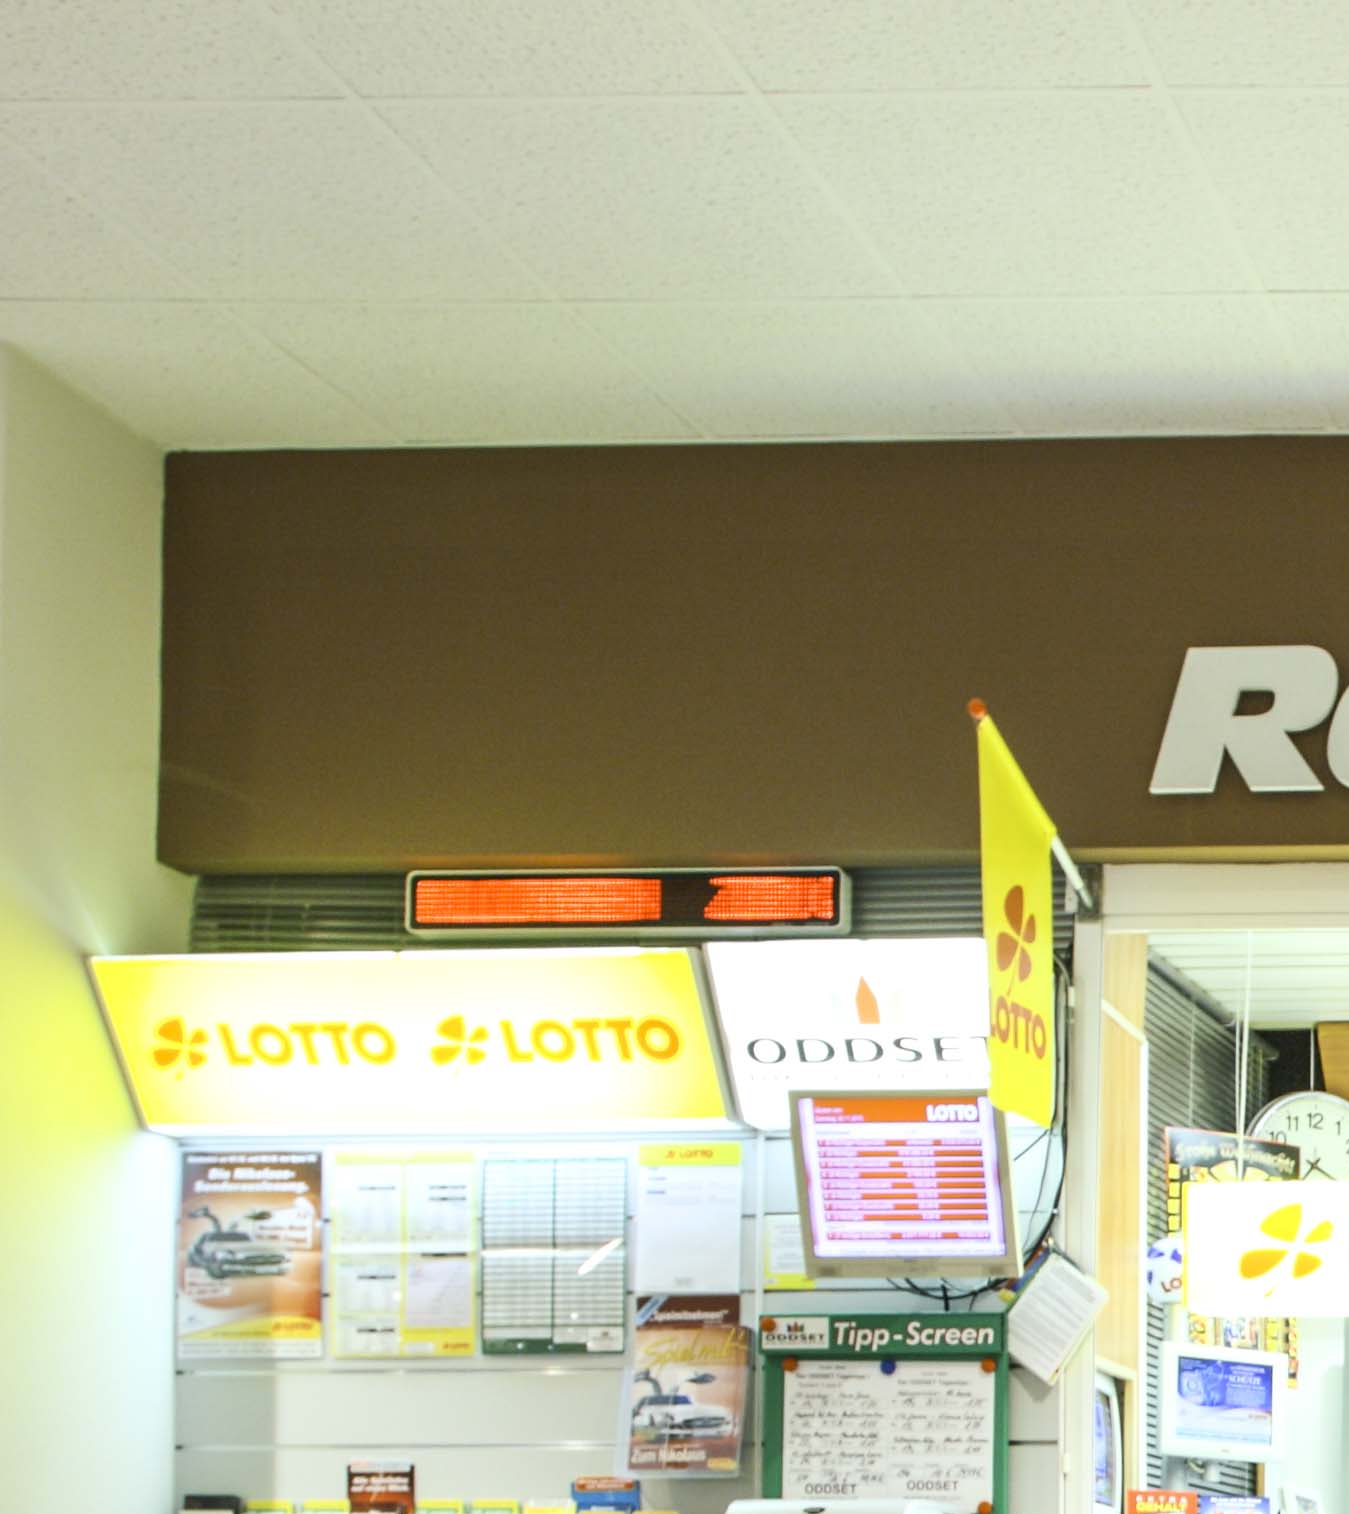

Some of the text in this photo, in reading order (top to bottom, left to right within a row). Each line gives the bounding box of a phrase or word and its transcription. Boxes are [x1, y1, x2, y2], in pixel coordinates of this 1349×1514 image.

[990, 995, 1046, 1060] OTTO
[219, 1017, 681, 1067] LOTTO LOTTO
[925, 1103, 979, 1122] LOTTO
[1286, 1115, 1300, 1132] 11
[1306, 1112, 1324, 1130] 12
[1335, 1120, 1342, 1136] 1
[1269, 1131, 1288, 1145] 10
[765, 1333, 825, 1344] ODDSET
[804, 1482, 857, 1495] ODDSET
[906, 1479, 959, 1492] ODDSET
